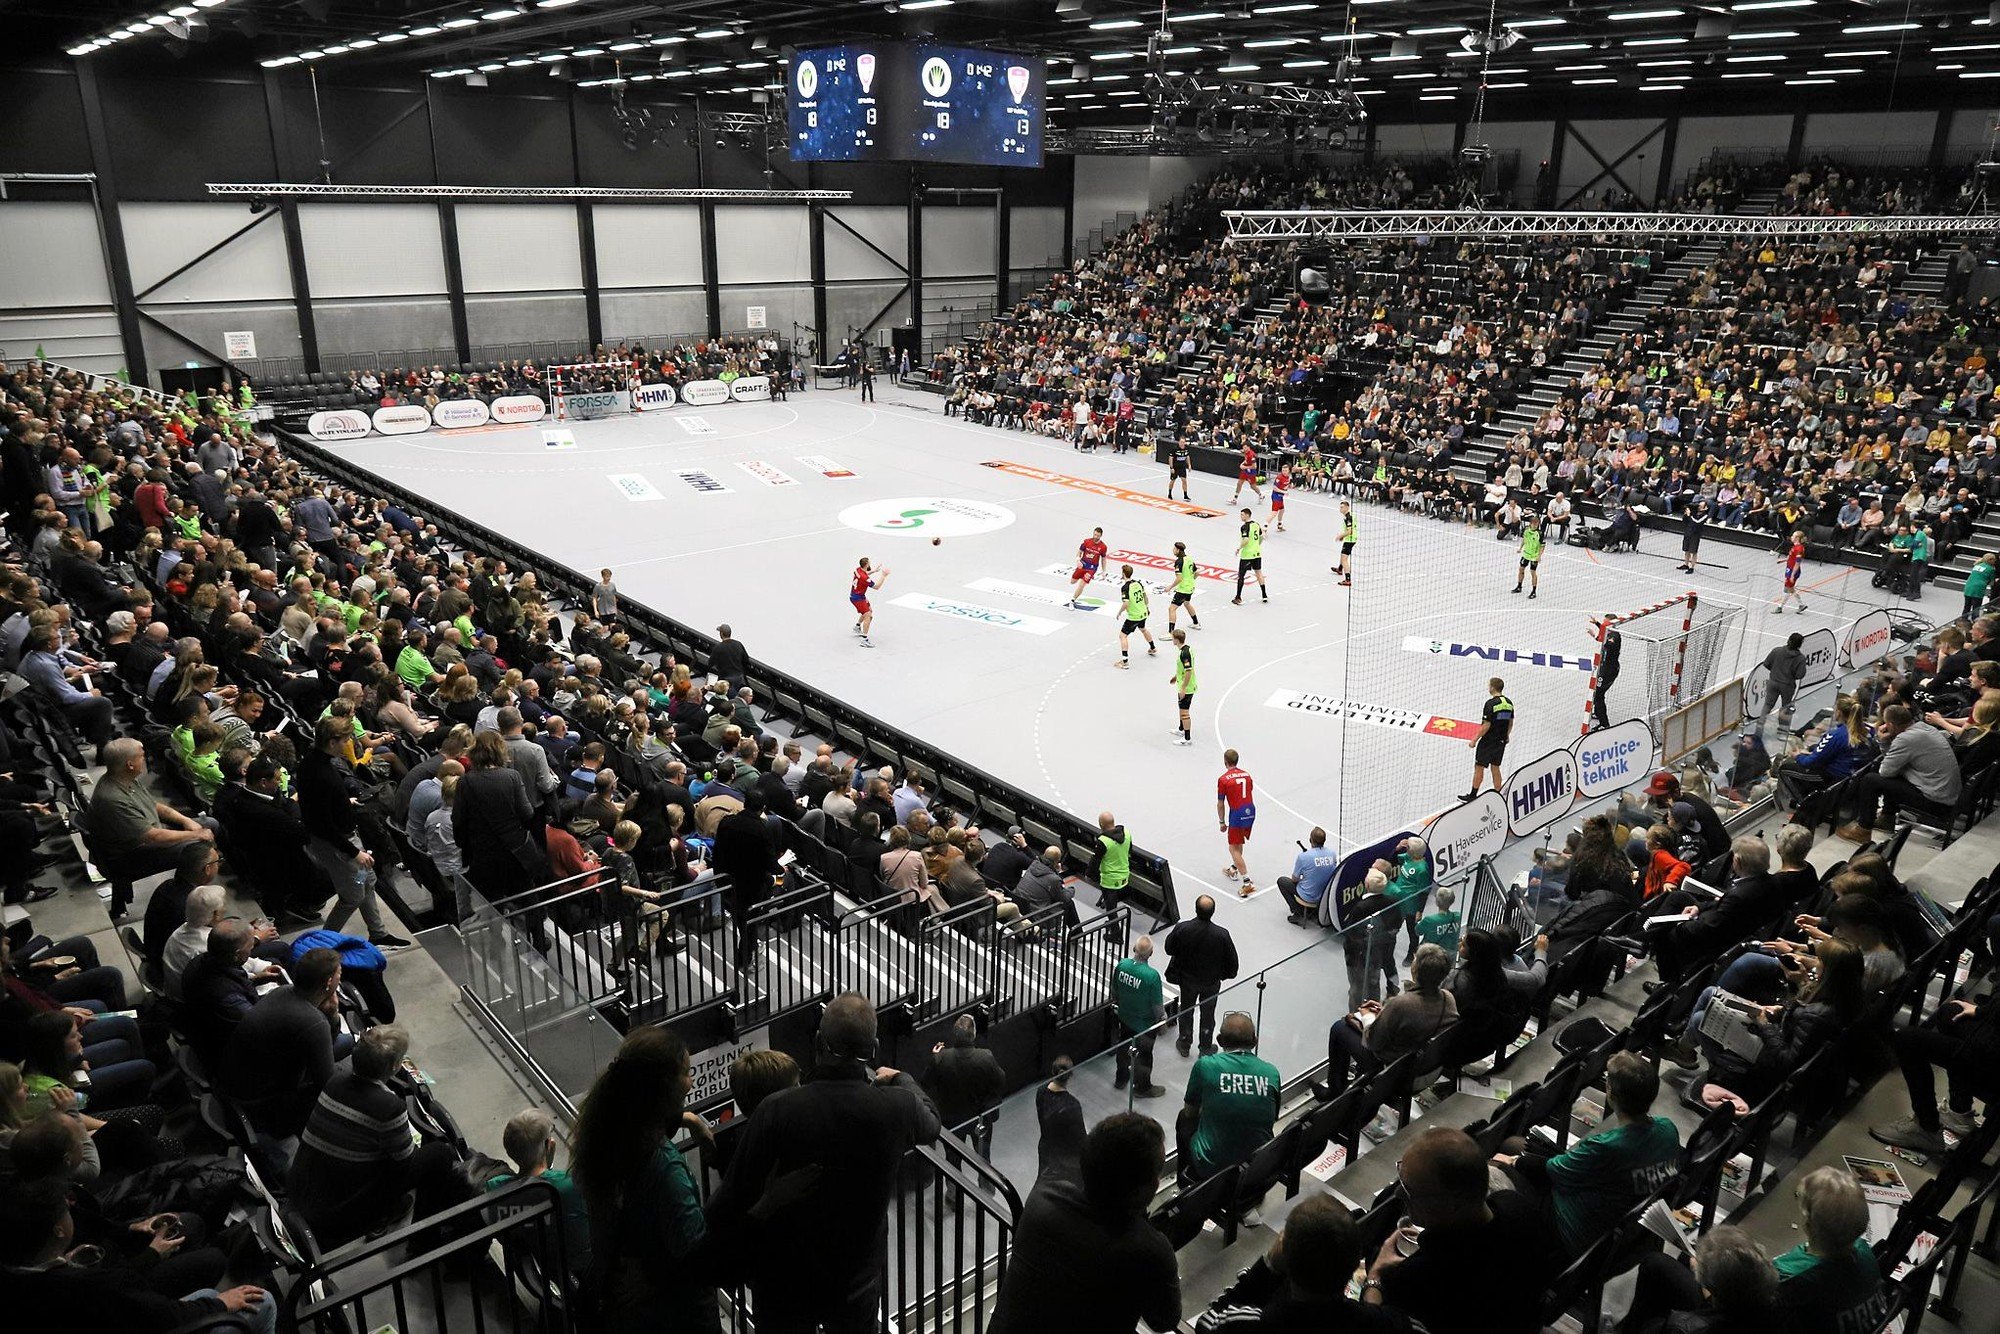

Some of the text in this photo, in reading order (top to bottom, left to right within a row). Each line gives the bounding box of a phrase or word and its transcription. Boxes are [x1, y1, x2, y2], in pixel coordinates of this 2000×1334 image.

[937, 112, 950, 129] 18
[1017, 118, 1029, 135] 13
[635, 389, 668, 403] HHM
[735, 384, 762, 394] CRAFT
[506, 404, 542, 415] NORDTAG
[1126, 494, 1193, 512] Primo
[1133, 589, 1143, 604] 23
[1860, 627, 1889, 650] NORDTAG
[1450, 643, 1593, 671] HHM
[1302, 694, 1422, 720] KOMMUNE
[1582, 739, 1640, 768] Service-
[1583, 758, 1629, 786] teknik
[1236, 778, 1247, 798] 7
[1512, 766, 1565, 821] HHM
[1435, 845, 1458, 877] SL
[1455, 817, 1503, 859] Haveservice
[1314, 856, 1334, 867] CREW
[1436, 922, 1460, 935] CREW
[1117, 970, 1142, 990] CREW
[690, 1042, 754, 1077] OTPUNKT
[685, 1079, 729, 1104] TRIBU
[1219, 1072, 1269, 1096] CREW
[1871, 1188, 1912, 1199] NORDTAG
